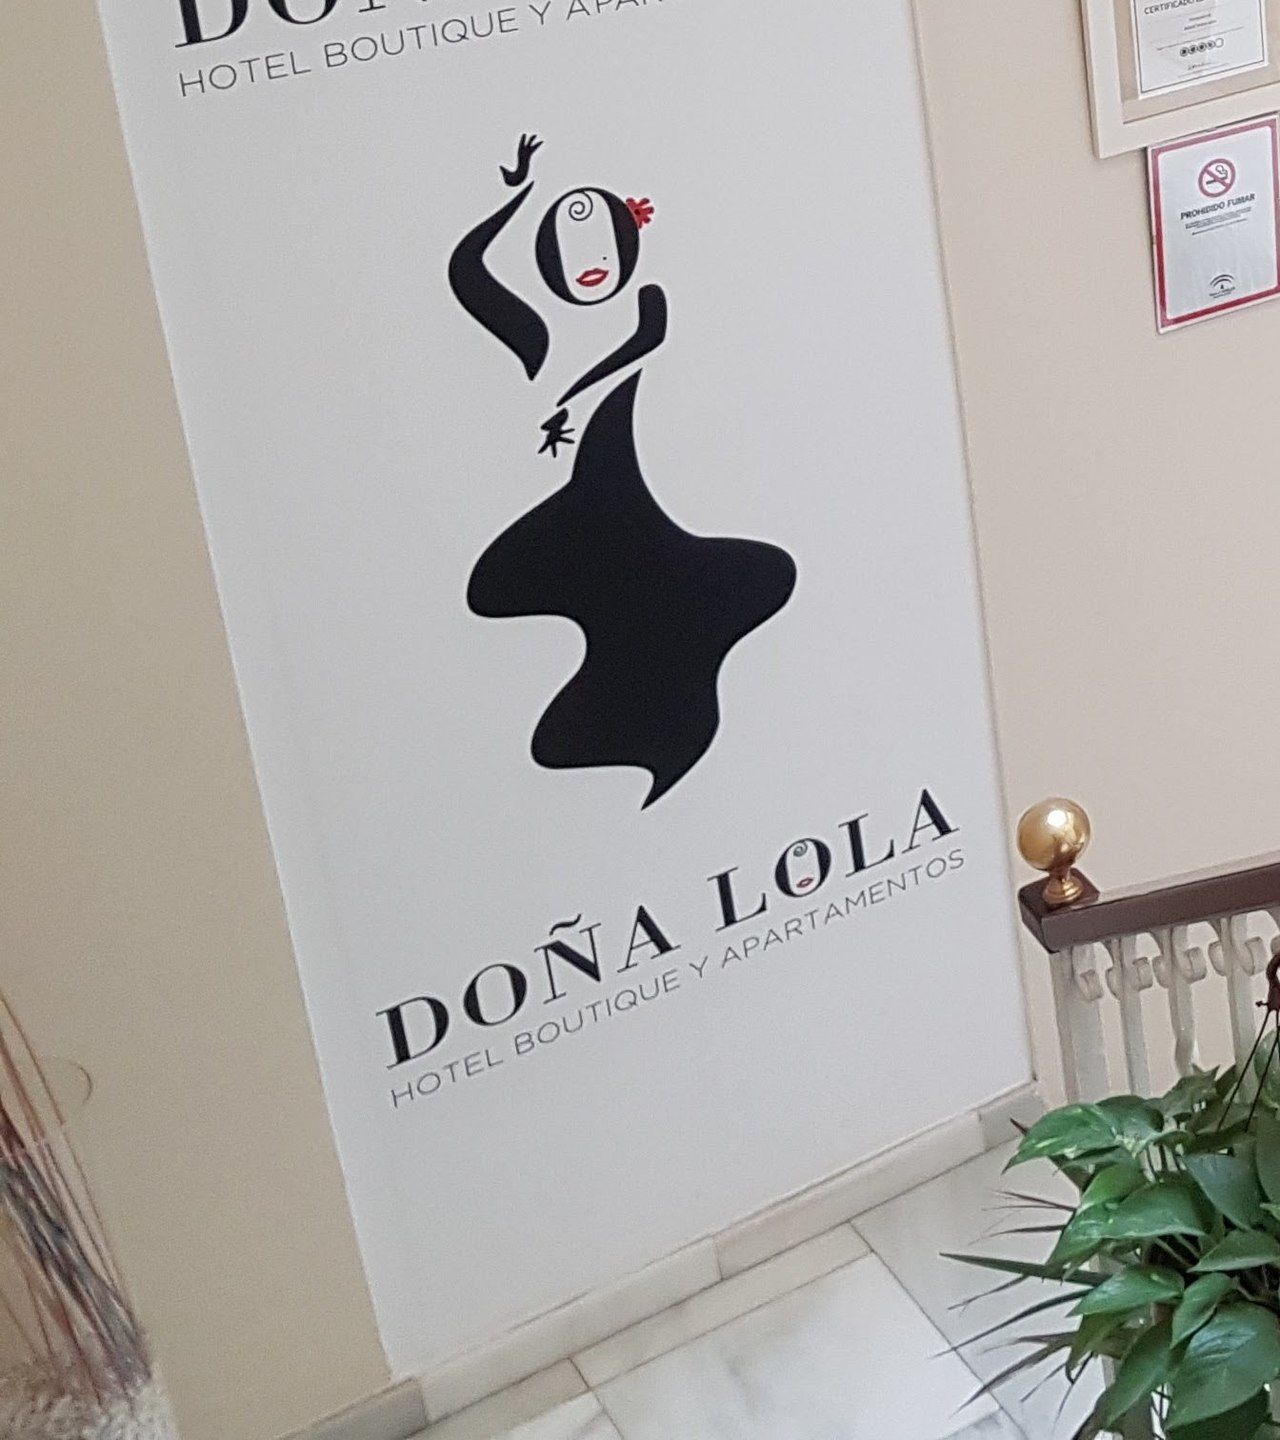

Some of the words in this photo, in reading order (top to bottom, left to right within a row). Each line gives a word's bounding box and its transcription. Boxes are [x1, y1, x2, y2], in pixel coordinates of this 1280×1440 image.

[178, 50, 312, 98] HOTEL
[323, 7, 520, 69] BOUTIQUE
[528, 0, 552, 26] Y
[1180, 201, 1225, 221] PROHIBIDO
[1227, 193, 1256, 207] FUMAR
[375, 904, 682, 1070] DOÑA
[707, 787, 960, 934] LOLA
[390, 1047, 505, 1109] HOTEL
[513, 969, 683, 1056] BOUTIQUE
[688, 956, 712, 979] Y
[720, 848, 966, 969] APARTAMENTOS
